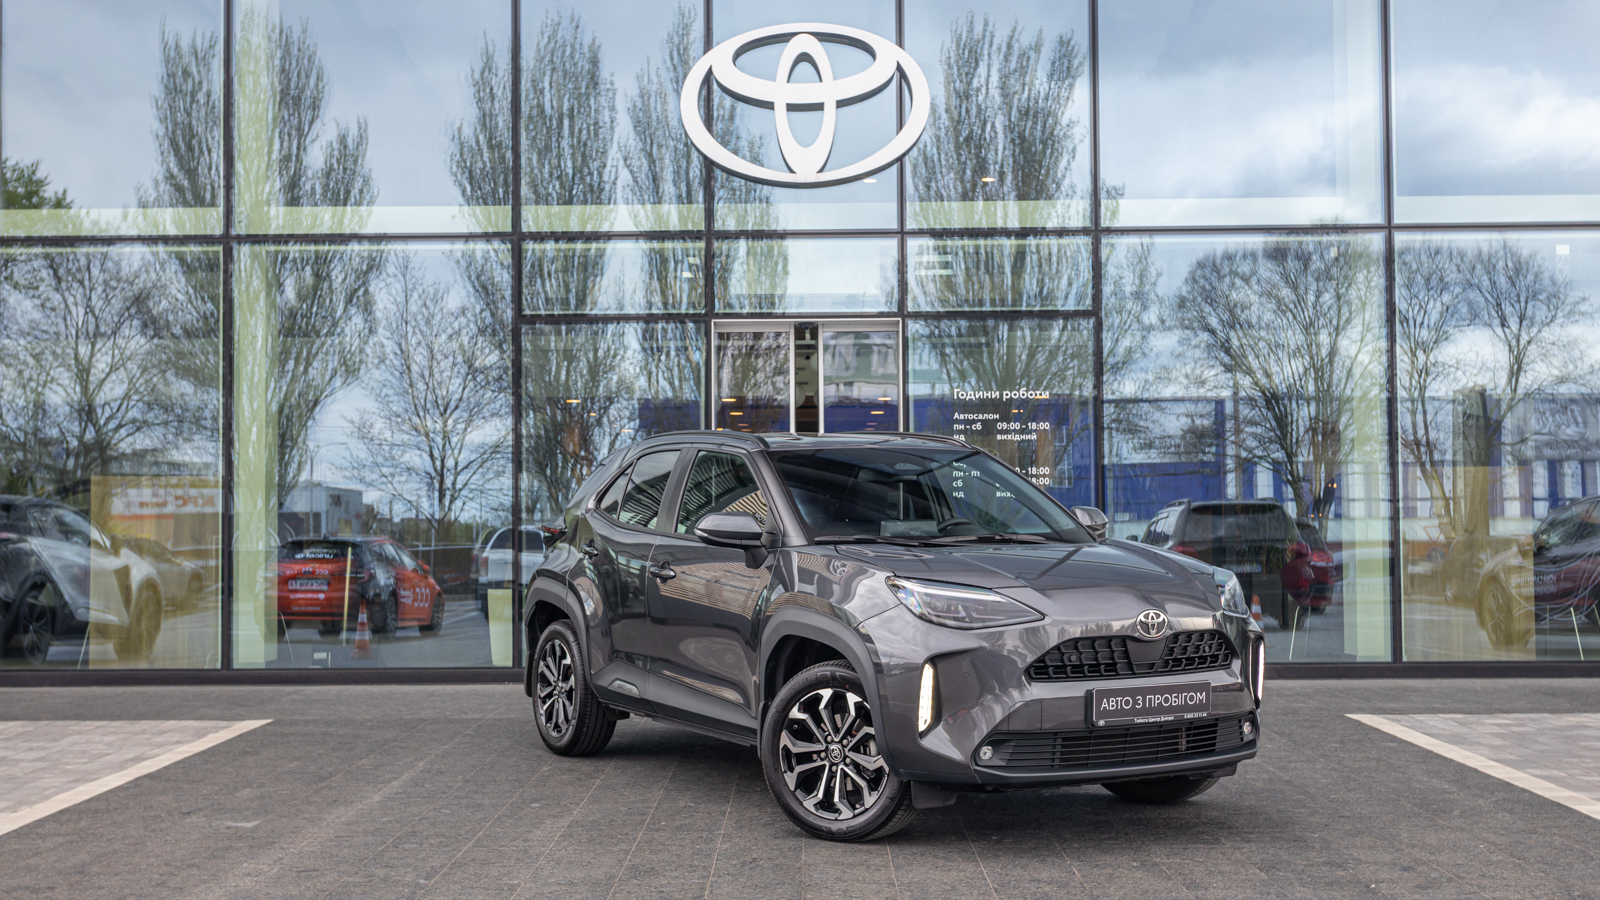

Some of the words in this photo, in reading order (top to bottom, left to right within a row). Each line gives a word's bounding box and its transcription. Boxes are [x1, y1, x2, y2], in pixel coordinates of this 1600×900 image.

[953, 388, 1000, 400] Години
[1002, 388, 1050, 401] роботи
[953, 412, 1000, 420] Автосалон
[972, 422, 982, 430] сб
[996, 432, 1037, 441] вихідний
[1100, 696, 1132, 710] АВТО
[1146, 692, 1206, 708] ПРОБІГОМ
